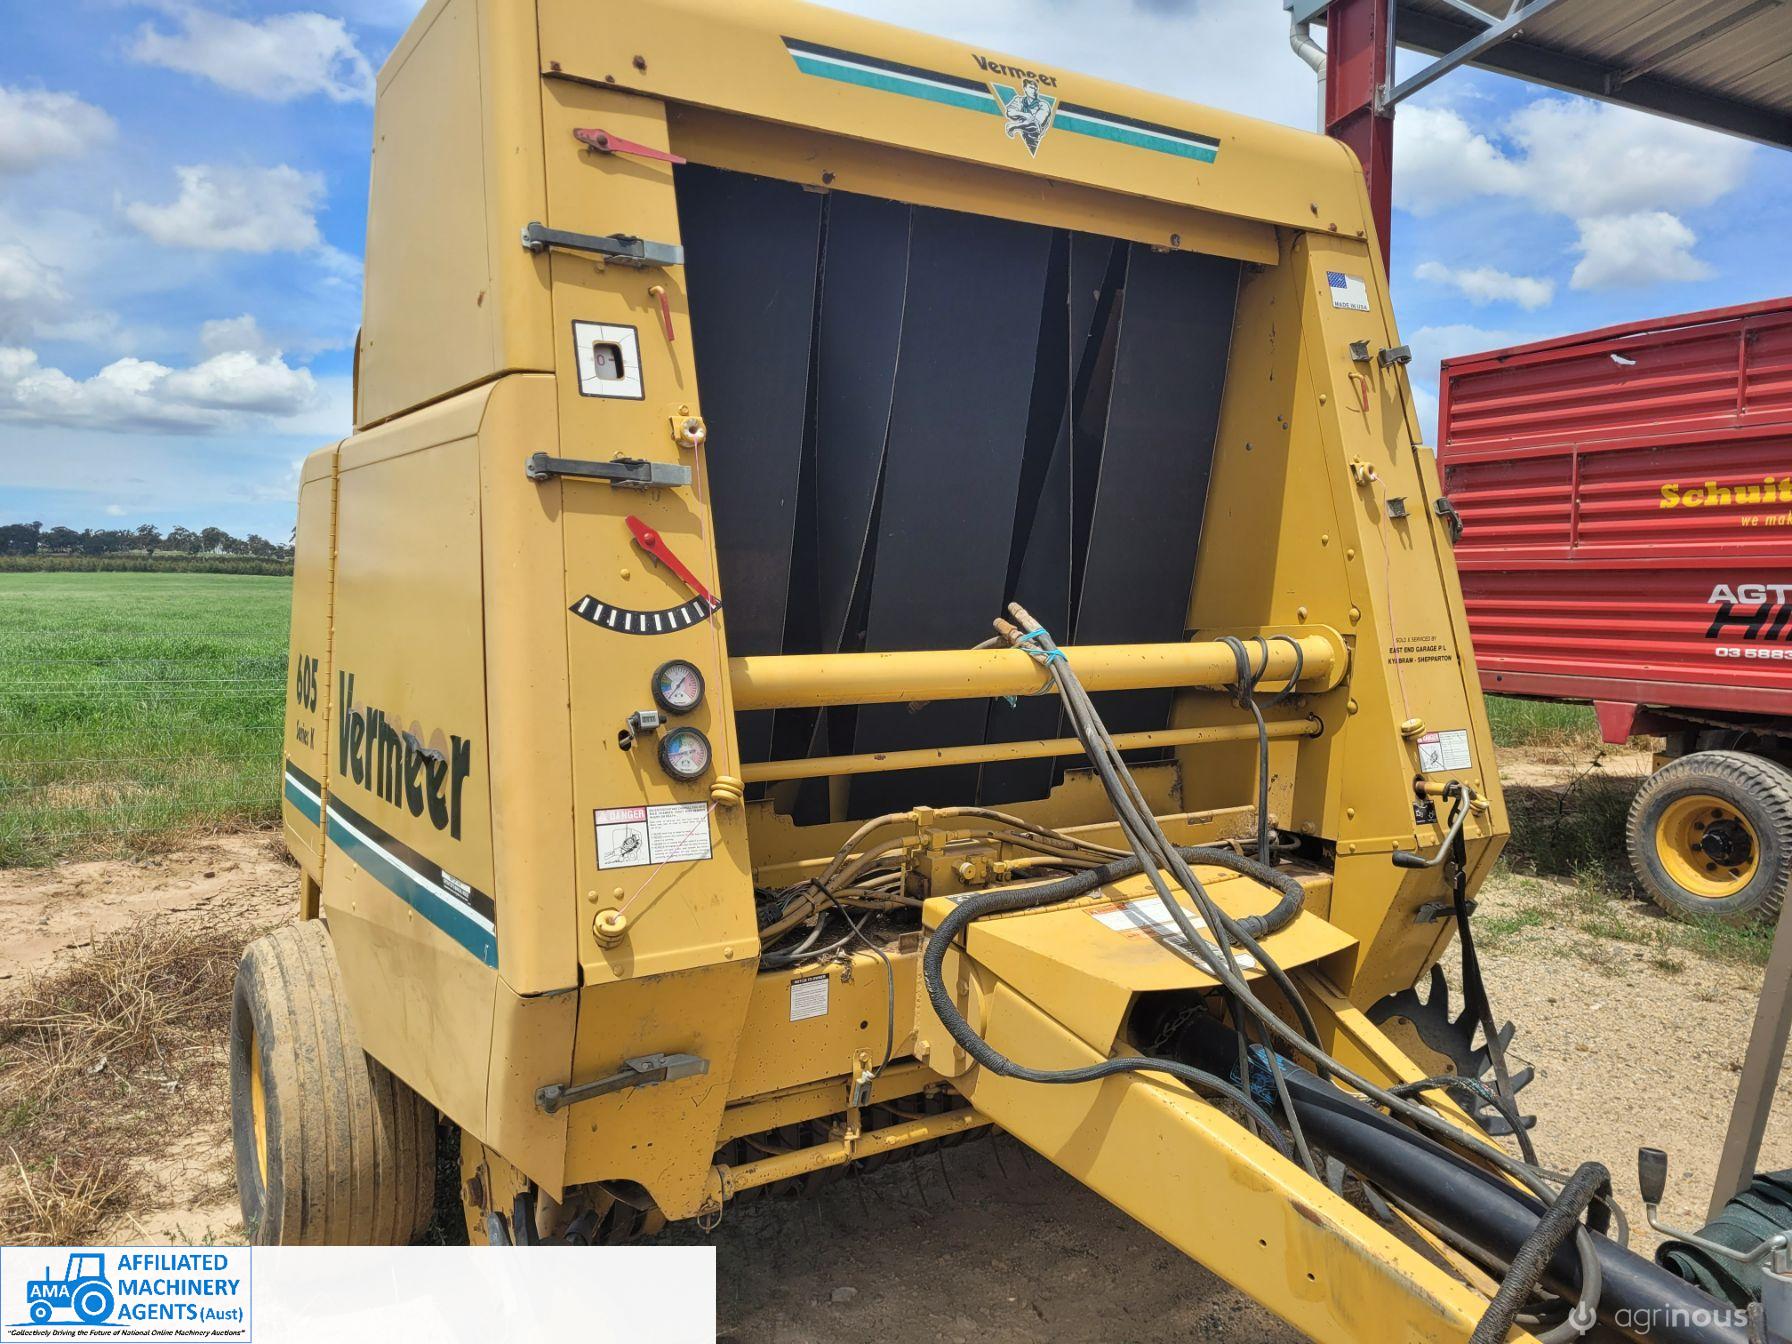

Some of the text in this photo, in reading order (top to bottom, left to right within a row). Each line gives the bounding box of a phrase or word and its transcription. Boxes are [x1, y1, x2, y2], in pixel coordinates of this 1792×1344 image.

[971, 53, 1057, 88] Vermeer
[1741, 515, 1759, 527] we
[1707, 584, 1792, 604] AGT
[1715, 647, 1741, 658] 03
[296, 653, 319, 714] 605
[338, 669, 471, 842] Vermeer
